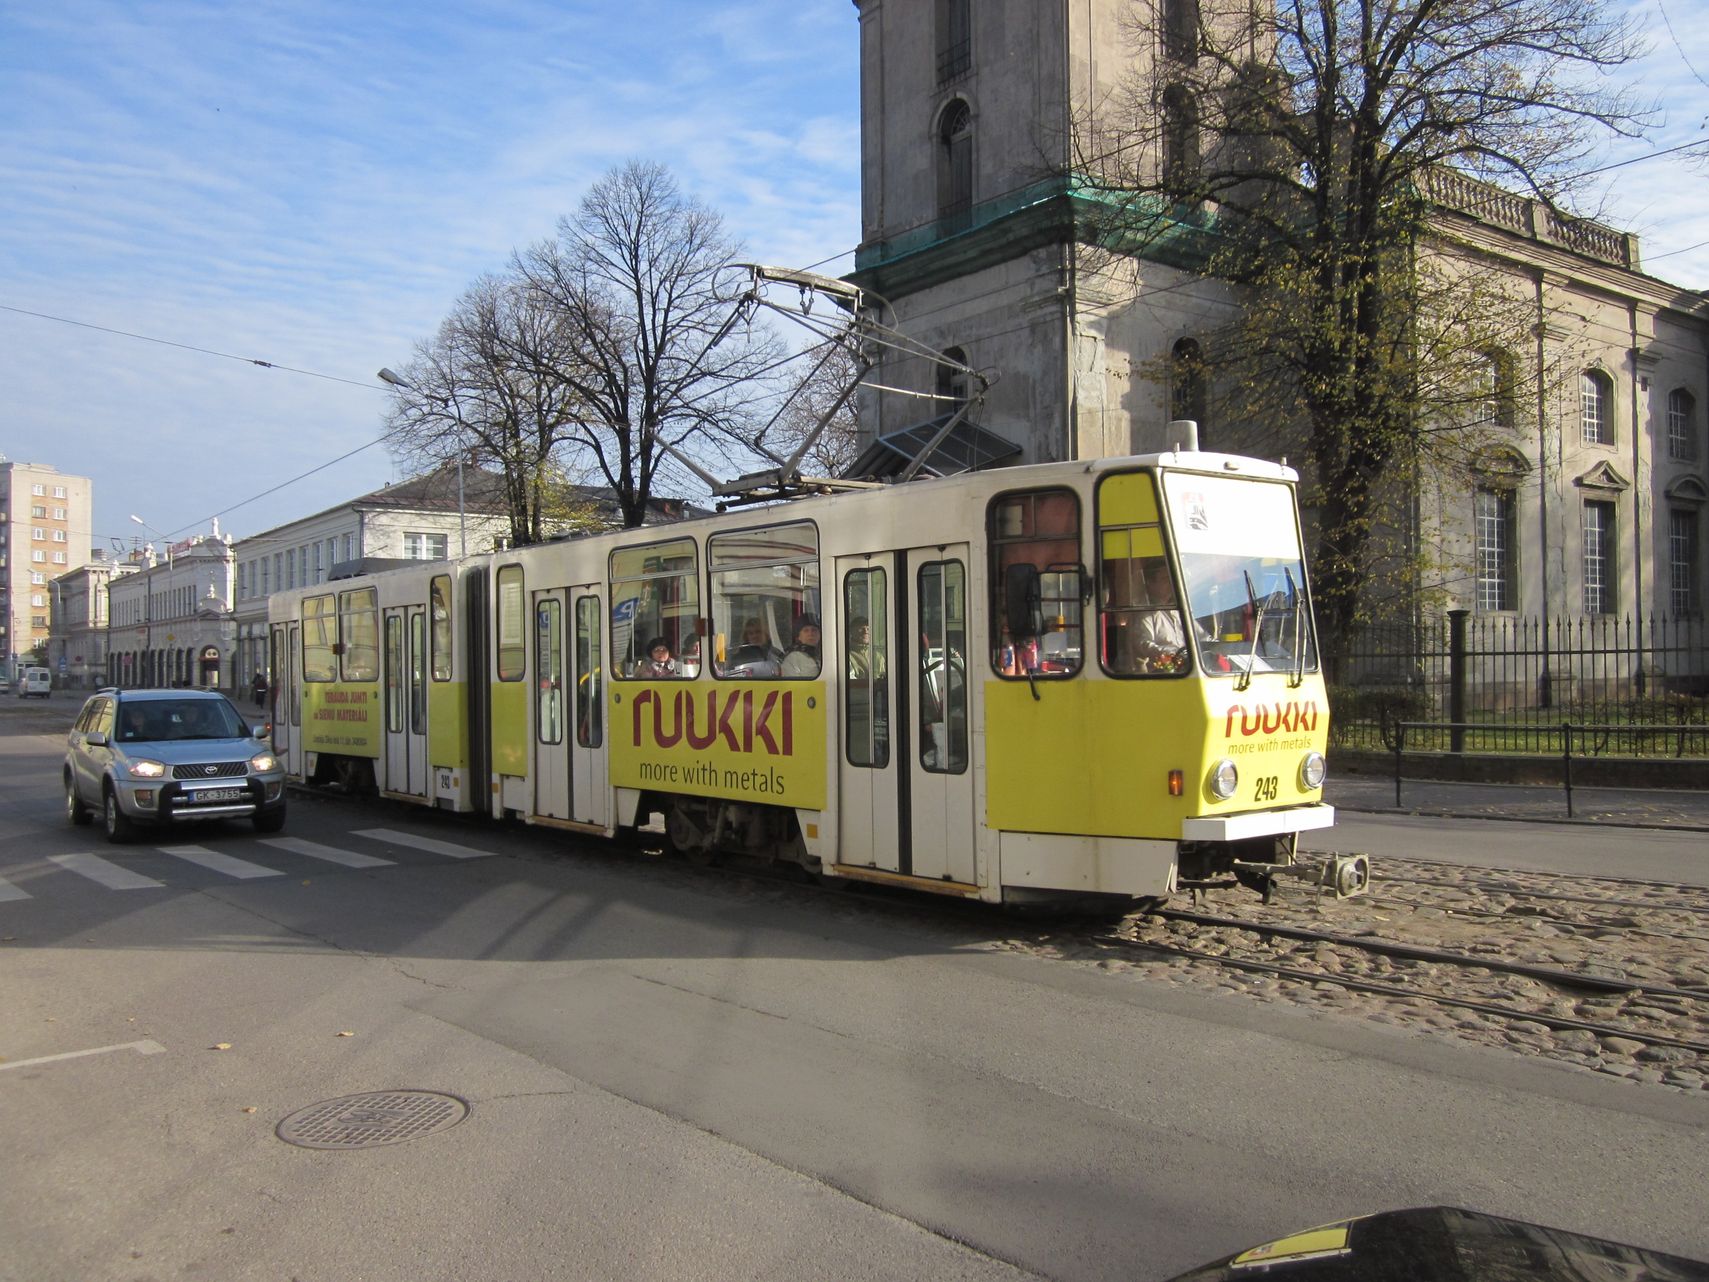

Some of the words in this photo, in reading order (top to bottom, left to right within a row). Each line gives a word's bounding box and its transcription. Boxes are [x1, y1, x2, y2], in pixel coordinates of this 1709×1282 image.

[1228, 743, 1255, 754] more
[1257, 739, 1279, 752] with
[1280, 736, 1312, 750] metals
[640, 762, 678, 782] more
[683, 760, 718, 787] with
[724, 767, 785, 795] metals
[1254, 776, 1278, 802] 243
